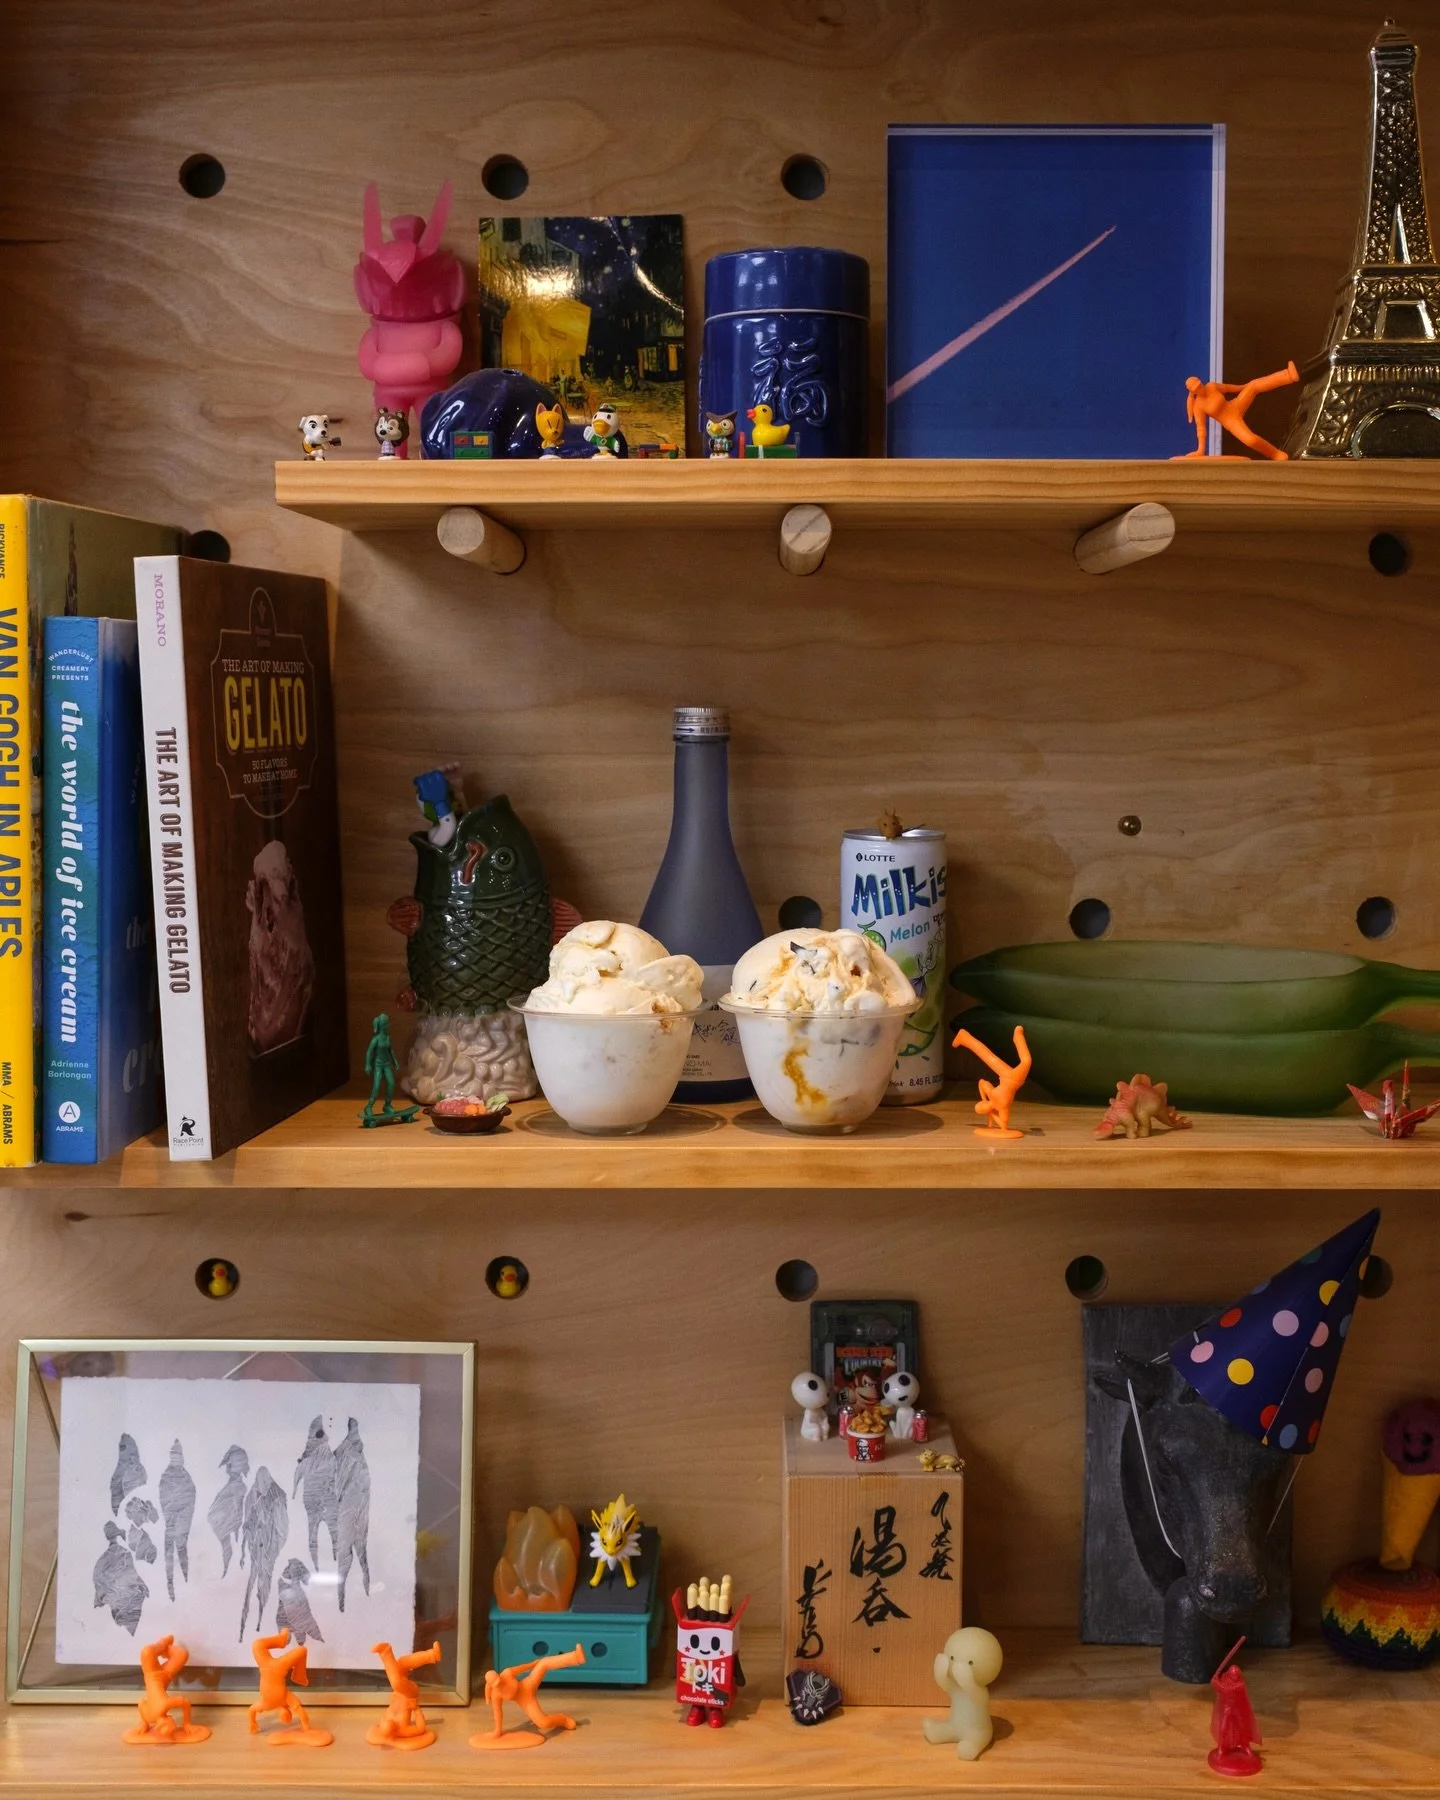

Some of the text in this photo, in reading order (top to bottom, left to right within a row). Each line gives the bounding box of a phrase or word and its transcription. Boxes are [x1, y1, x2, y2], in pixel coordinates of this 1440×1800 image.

[153, 573, 167, 648] MORANO
[47, 648, 94, 664] WANDERLUST
[51, 664, 90, 672] CREAMERY
[221, 659, 305, 674] THE ART OF MAKING
[223, 675, 308, 752] GELATO
[155, 726, 191, 994] THE ART OF MAKING GELATO
[864, 854, 896, 862] LOTTE
[56, 700, 83, 1043] the world of ice cream
[851, 865, 946, 920] Milkis
[889, 921, 930, 943] Melon
[50, 1060, 89, 1068] Adrienne
[1, 1061, 12, 1087] MMA
[48, 1070, 92, 1079] Borlongan
[909, 1077, 924, 1087] 8.45
[2, 1104, 14, 1145] ABRAMS
[56, 1125, 84, 1133] ABRAMS
[680, 1657, 726, 1685] Toki
[691, 1682, 714, 1695] トキ
[680, 1695, 725, 1706] chocolate sticks
